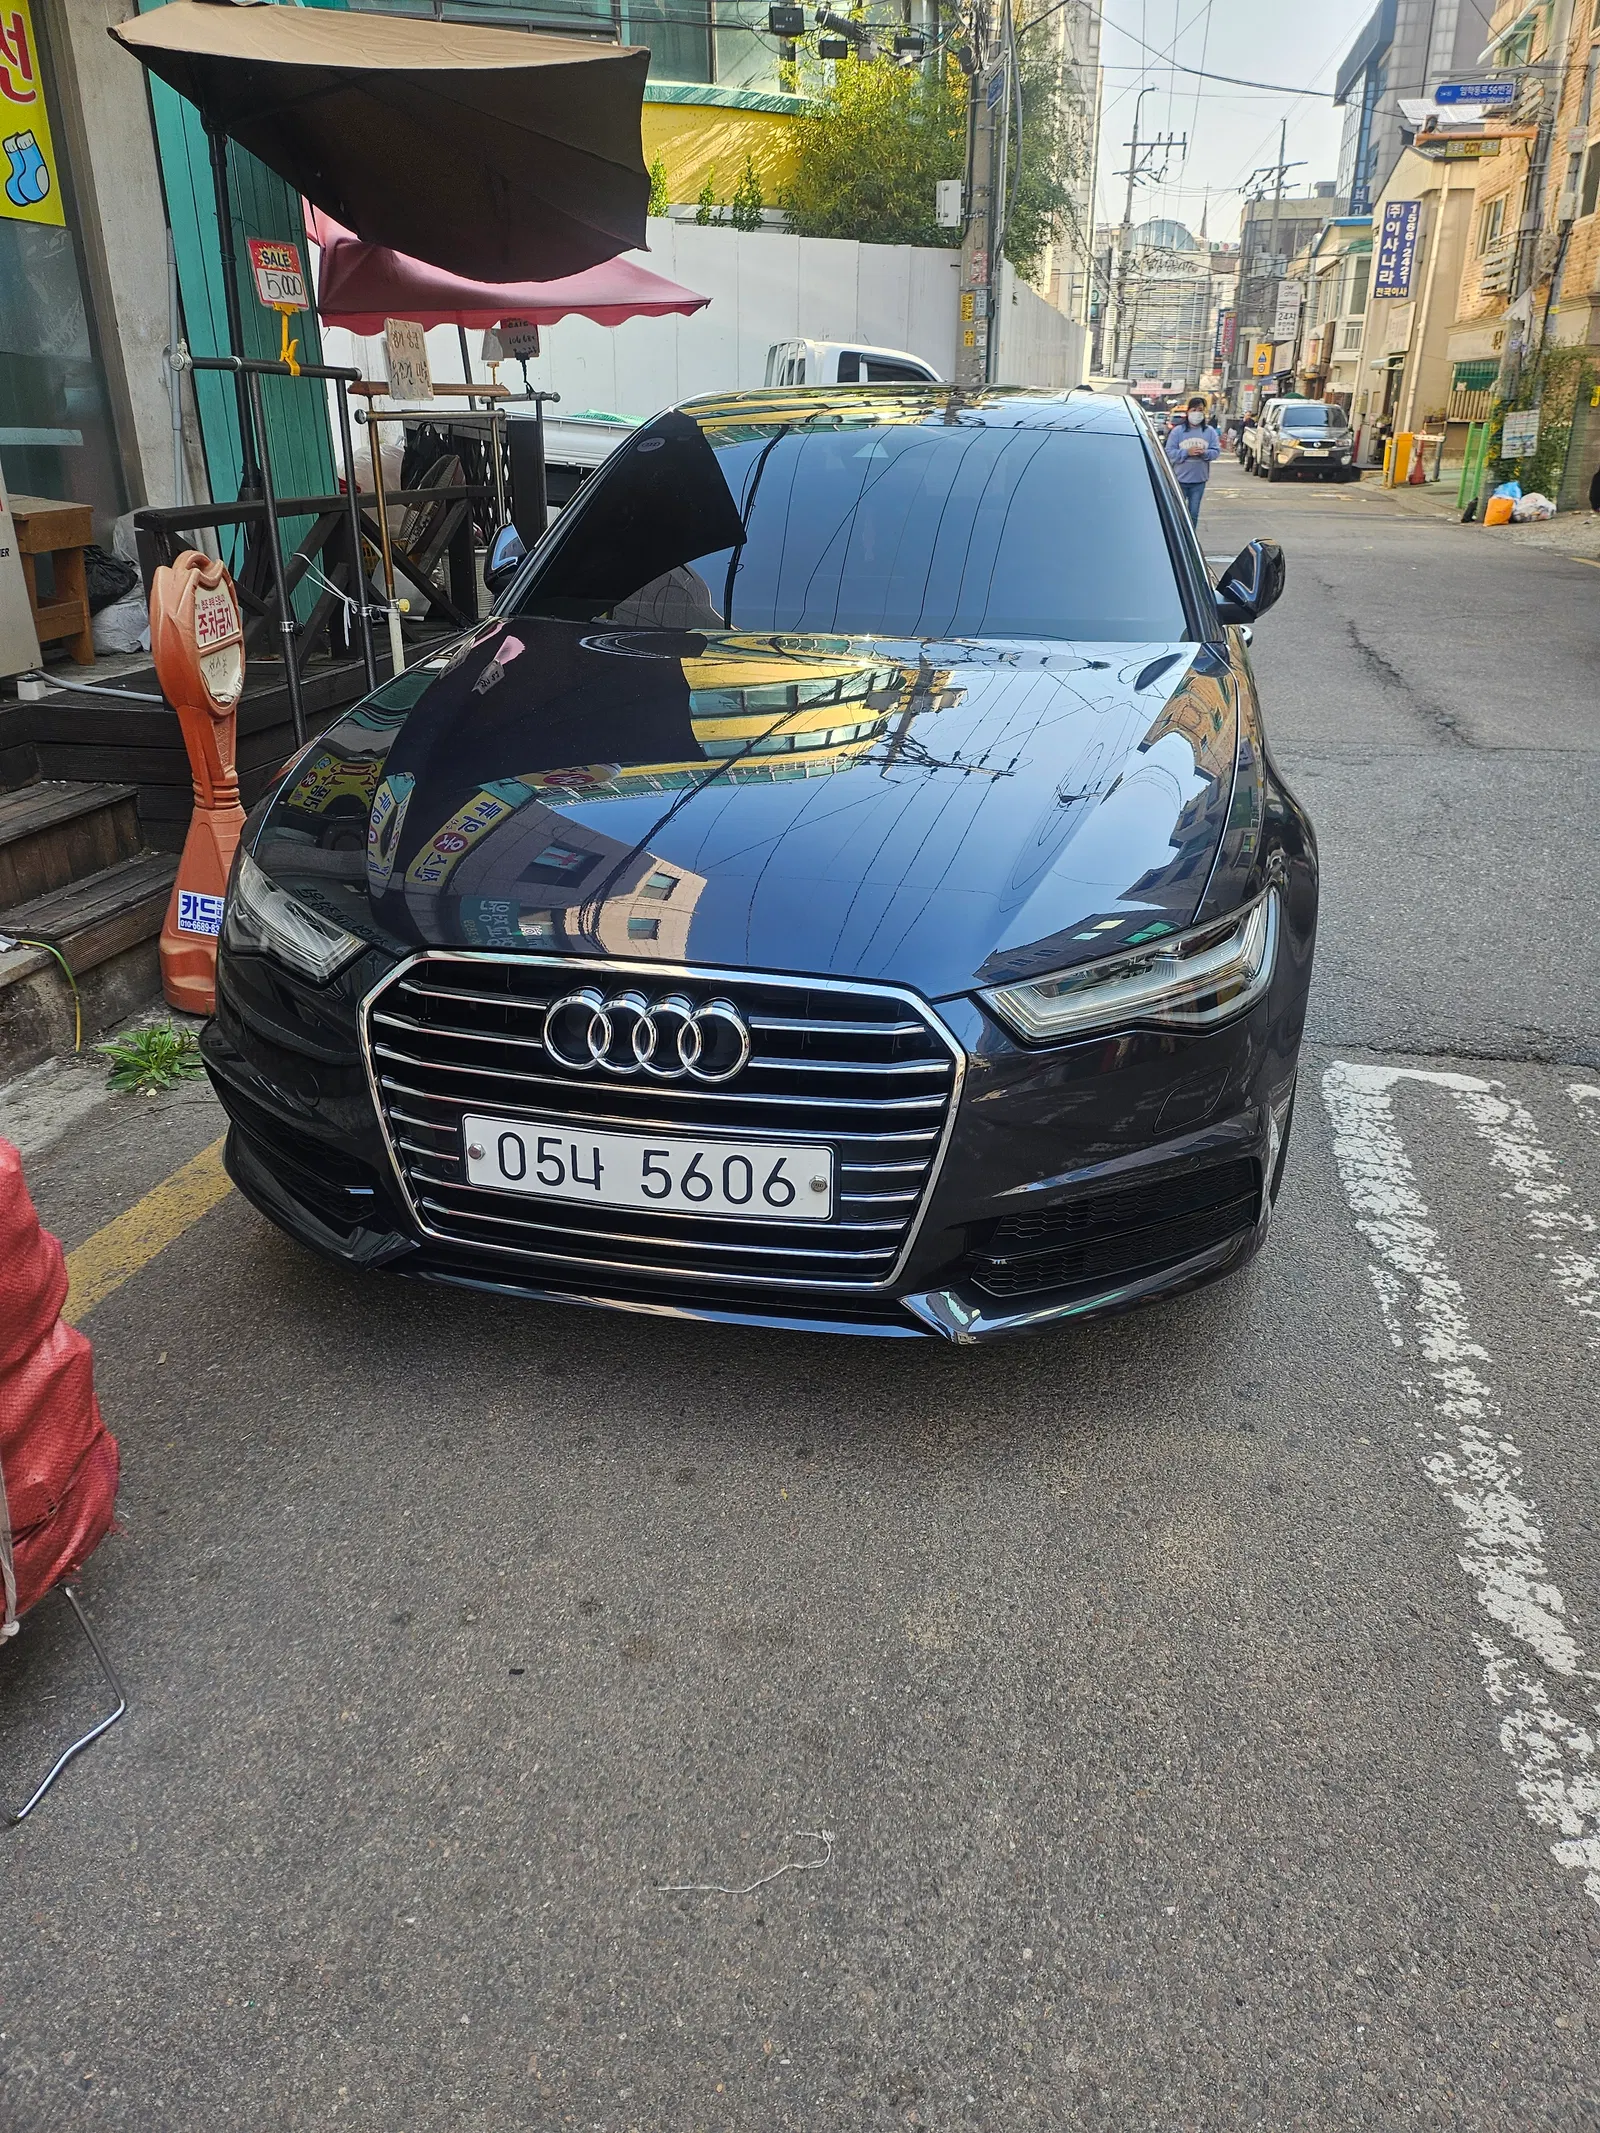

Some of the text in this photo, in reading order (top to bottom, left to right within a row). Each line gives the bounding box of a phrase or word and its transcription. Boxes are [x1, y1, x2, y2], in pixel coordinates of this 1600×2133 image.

[261, 250, 291, 267] SALE
[1399, 204, 1418, 285] 1566-2421
[1375, 287, 1408, 297] 전국이사
[198, 603, 234, 644] 주차금지
[182, 894, 216, 923] 카드
[497, 1131, 796, 1208] 05나 5606
